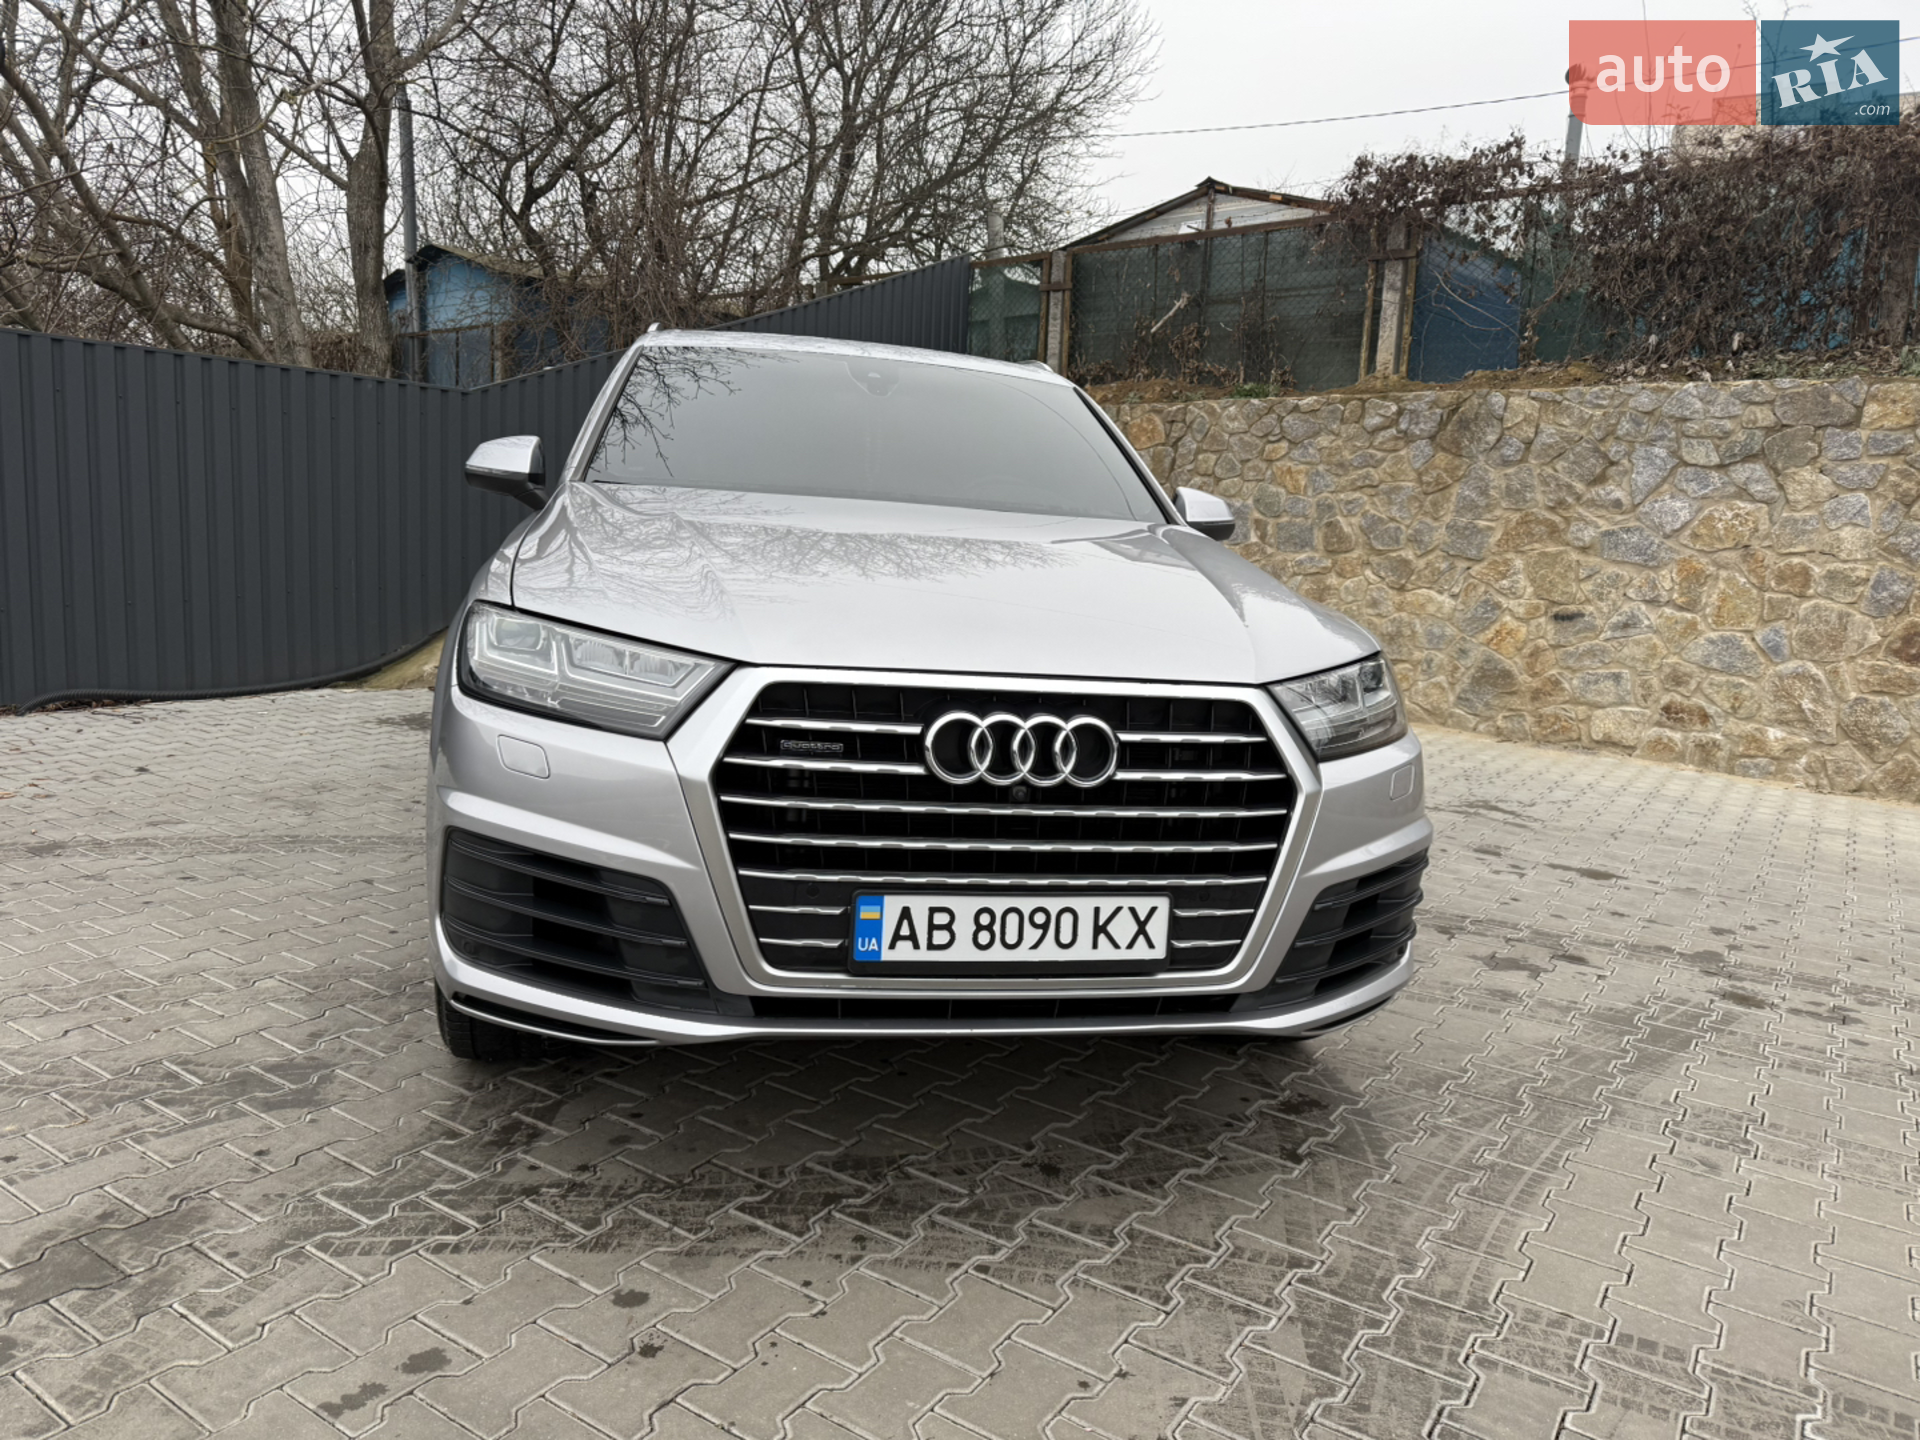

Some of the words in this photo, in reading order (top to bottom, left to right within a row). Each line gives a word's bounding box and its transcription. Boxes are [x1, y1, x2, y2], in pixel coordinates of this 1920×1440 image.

[783, 741, 841, 751] quattro
[887, 905, 956, 951] AB
[971, 906, 1080, 951] 8090
[1091, 905, 1159, 951] KX
[857, 937, 880, 952] UA
